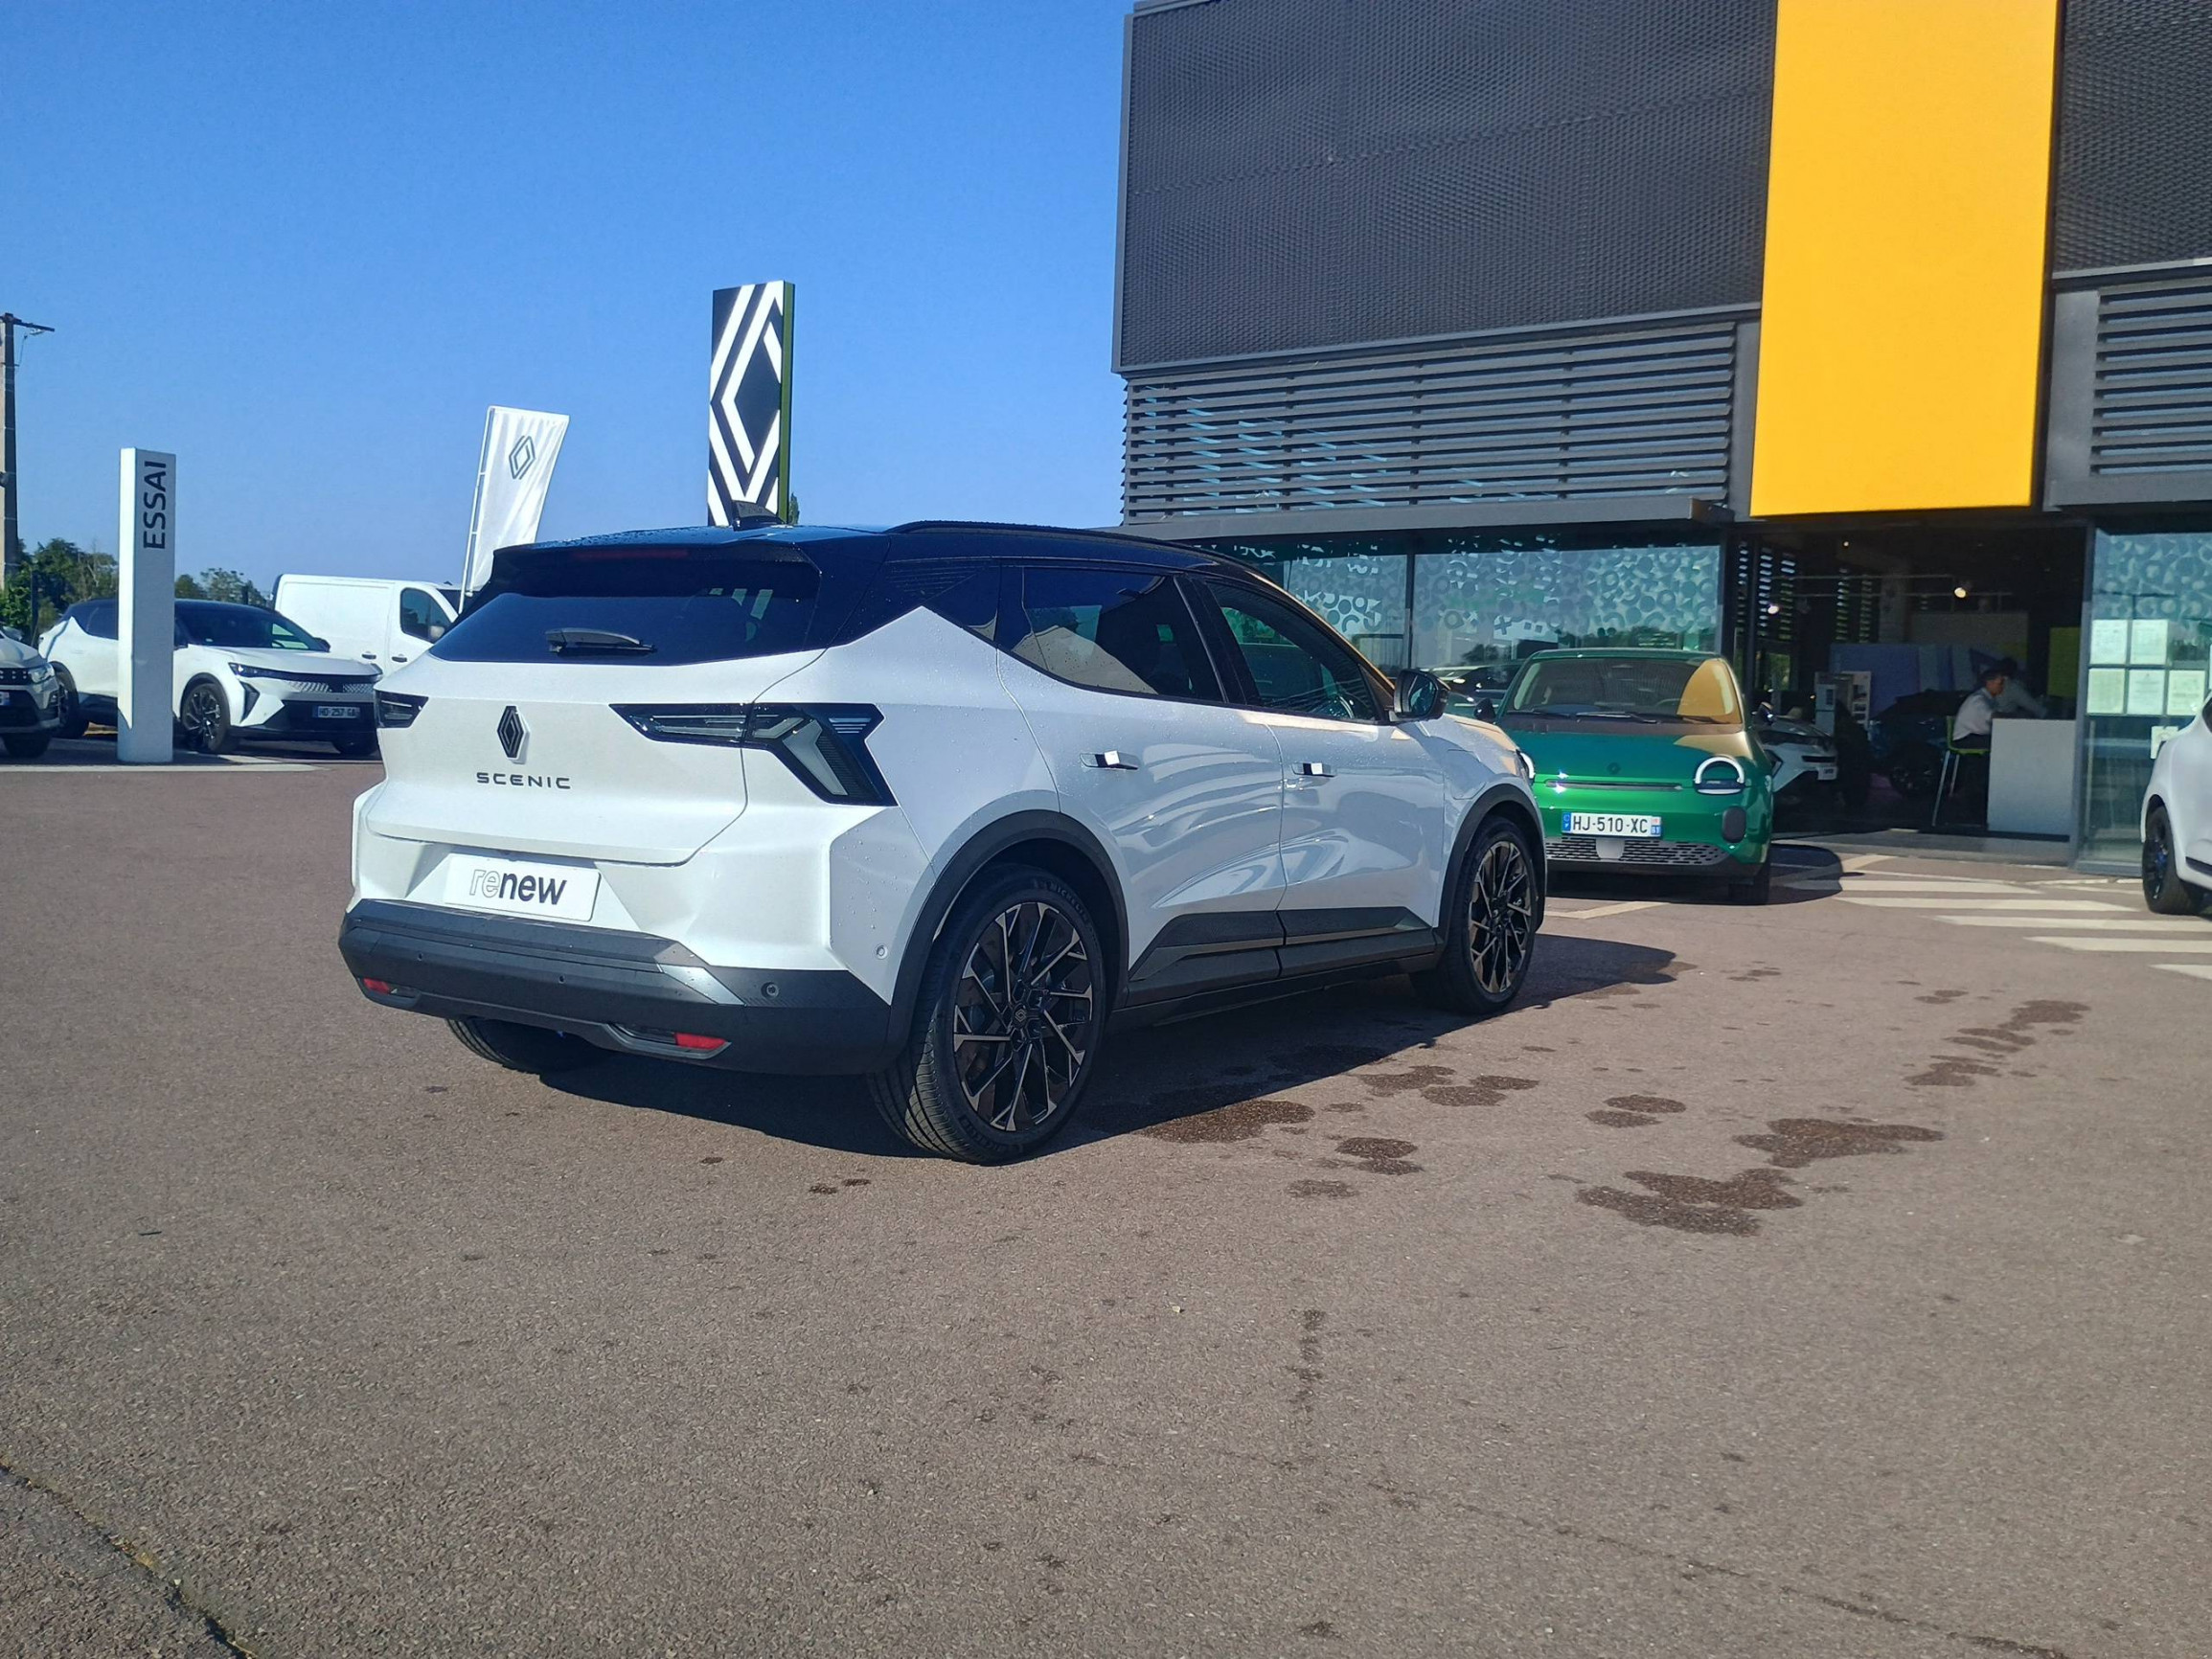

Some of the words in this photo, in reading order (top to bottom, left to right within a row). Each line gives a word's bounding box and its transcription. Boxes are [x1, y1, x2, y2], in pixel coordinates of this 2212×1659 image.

[143, 461, 167, 549] ESSAI
[476, 772, 571, 789] SCENIC
[1573, 815, 1648, 833] HJ-510-XC
[469, 869, 567, 905] renew
